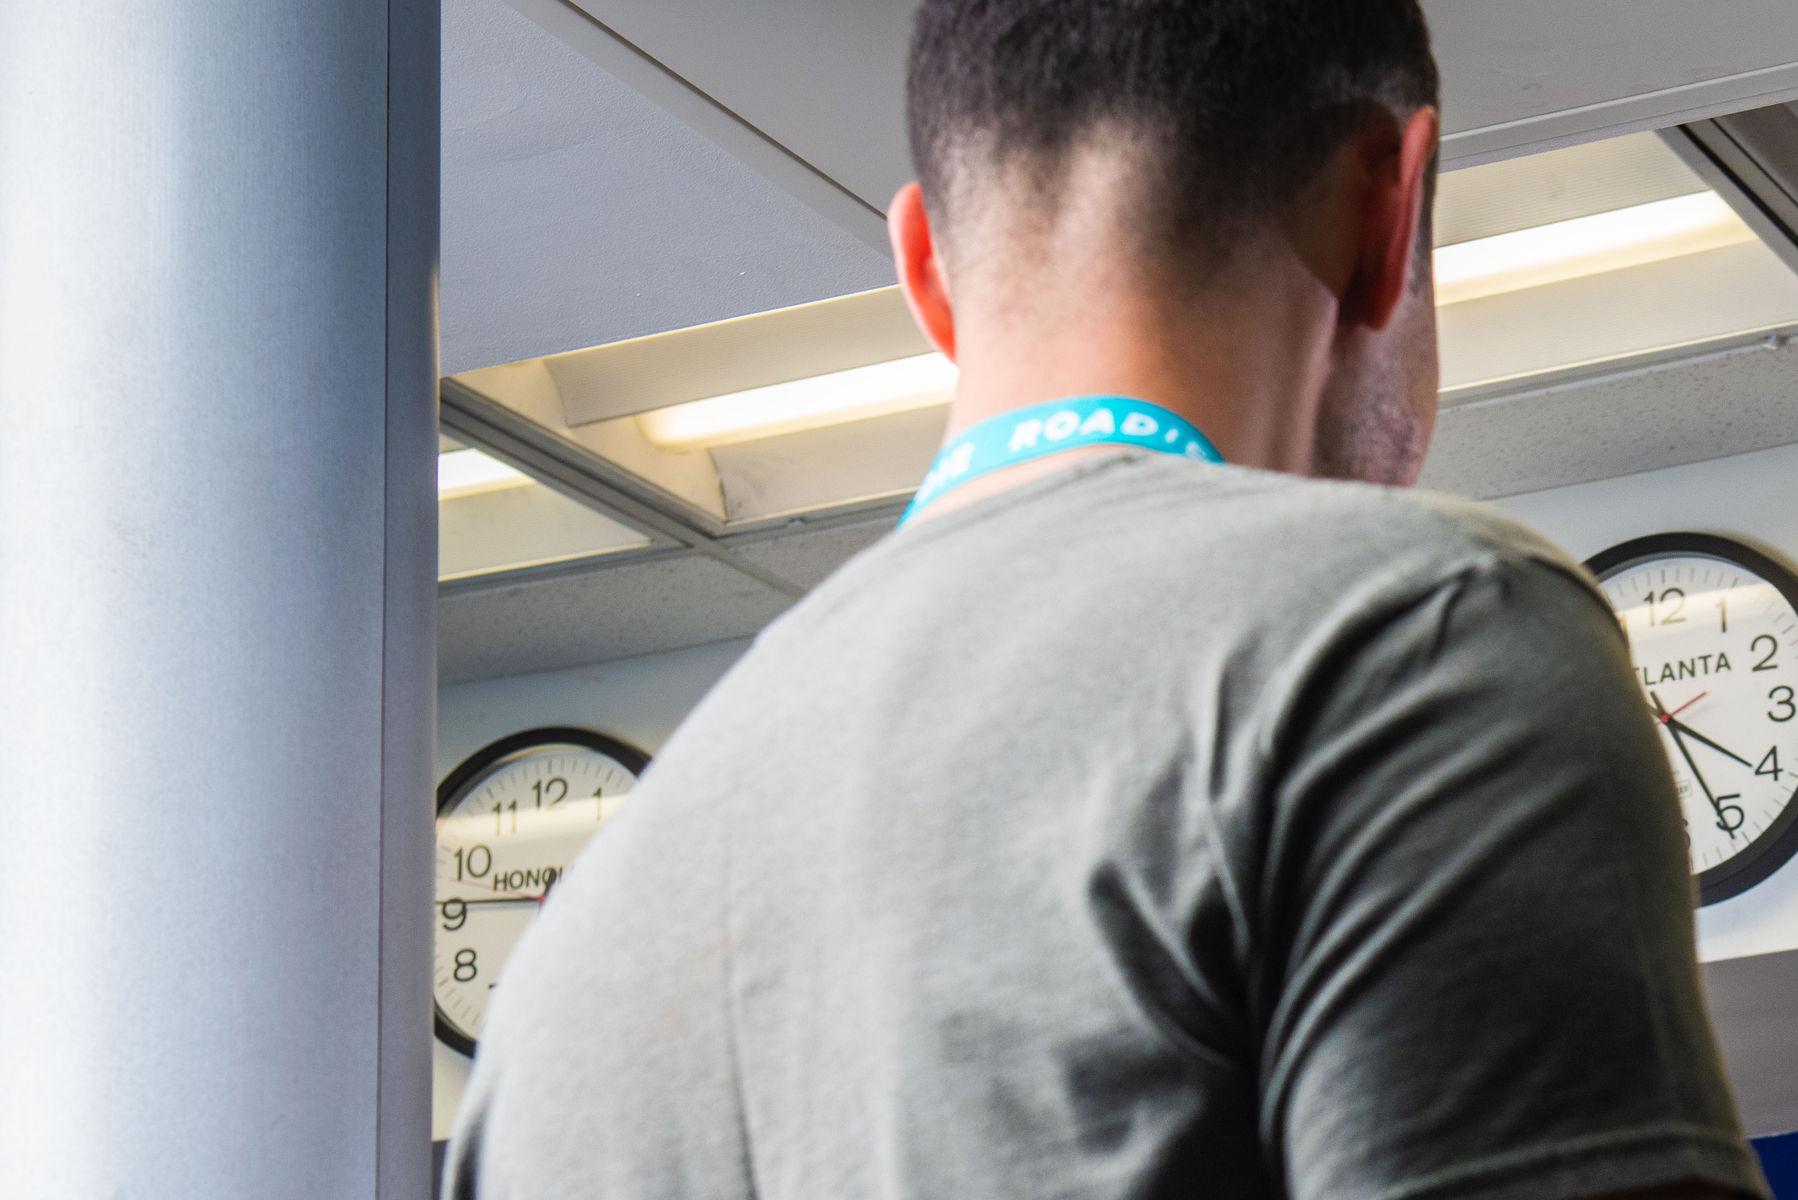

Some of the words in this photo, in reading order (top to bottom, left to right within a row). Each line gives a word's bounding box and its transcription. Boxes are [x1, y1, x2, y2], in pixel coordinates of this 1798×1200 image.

[1643, 587, 1687, 627] 12
[1715, 598, 1728, 634] 1
[1750, 634, 1778, 672] 2
[1767, 686, 1796, 722] 3
[1754, 745, 1783, 782] 4
[532, 778, 568, 811] 12
[591, 788, 603, 820] 1
[1716, 793, 1745, 832] 5
[491, 800, 518, 835] 11
[454, 845, 492, 881] 10
[494, 865, 563, 891] HONO
[442, 898, 467, 931] 9
[454, 949, 477, 982] 8
